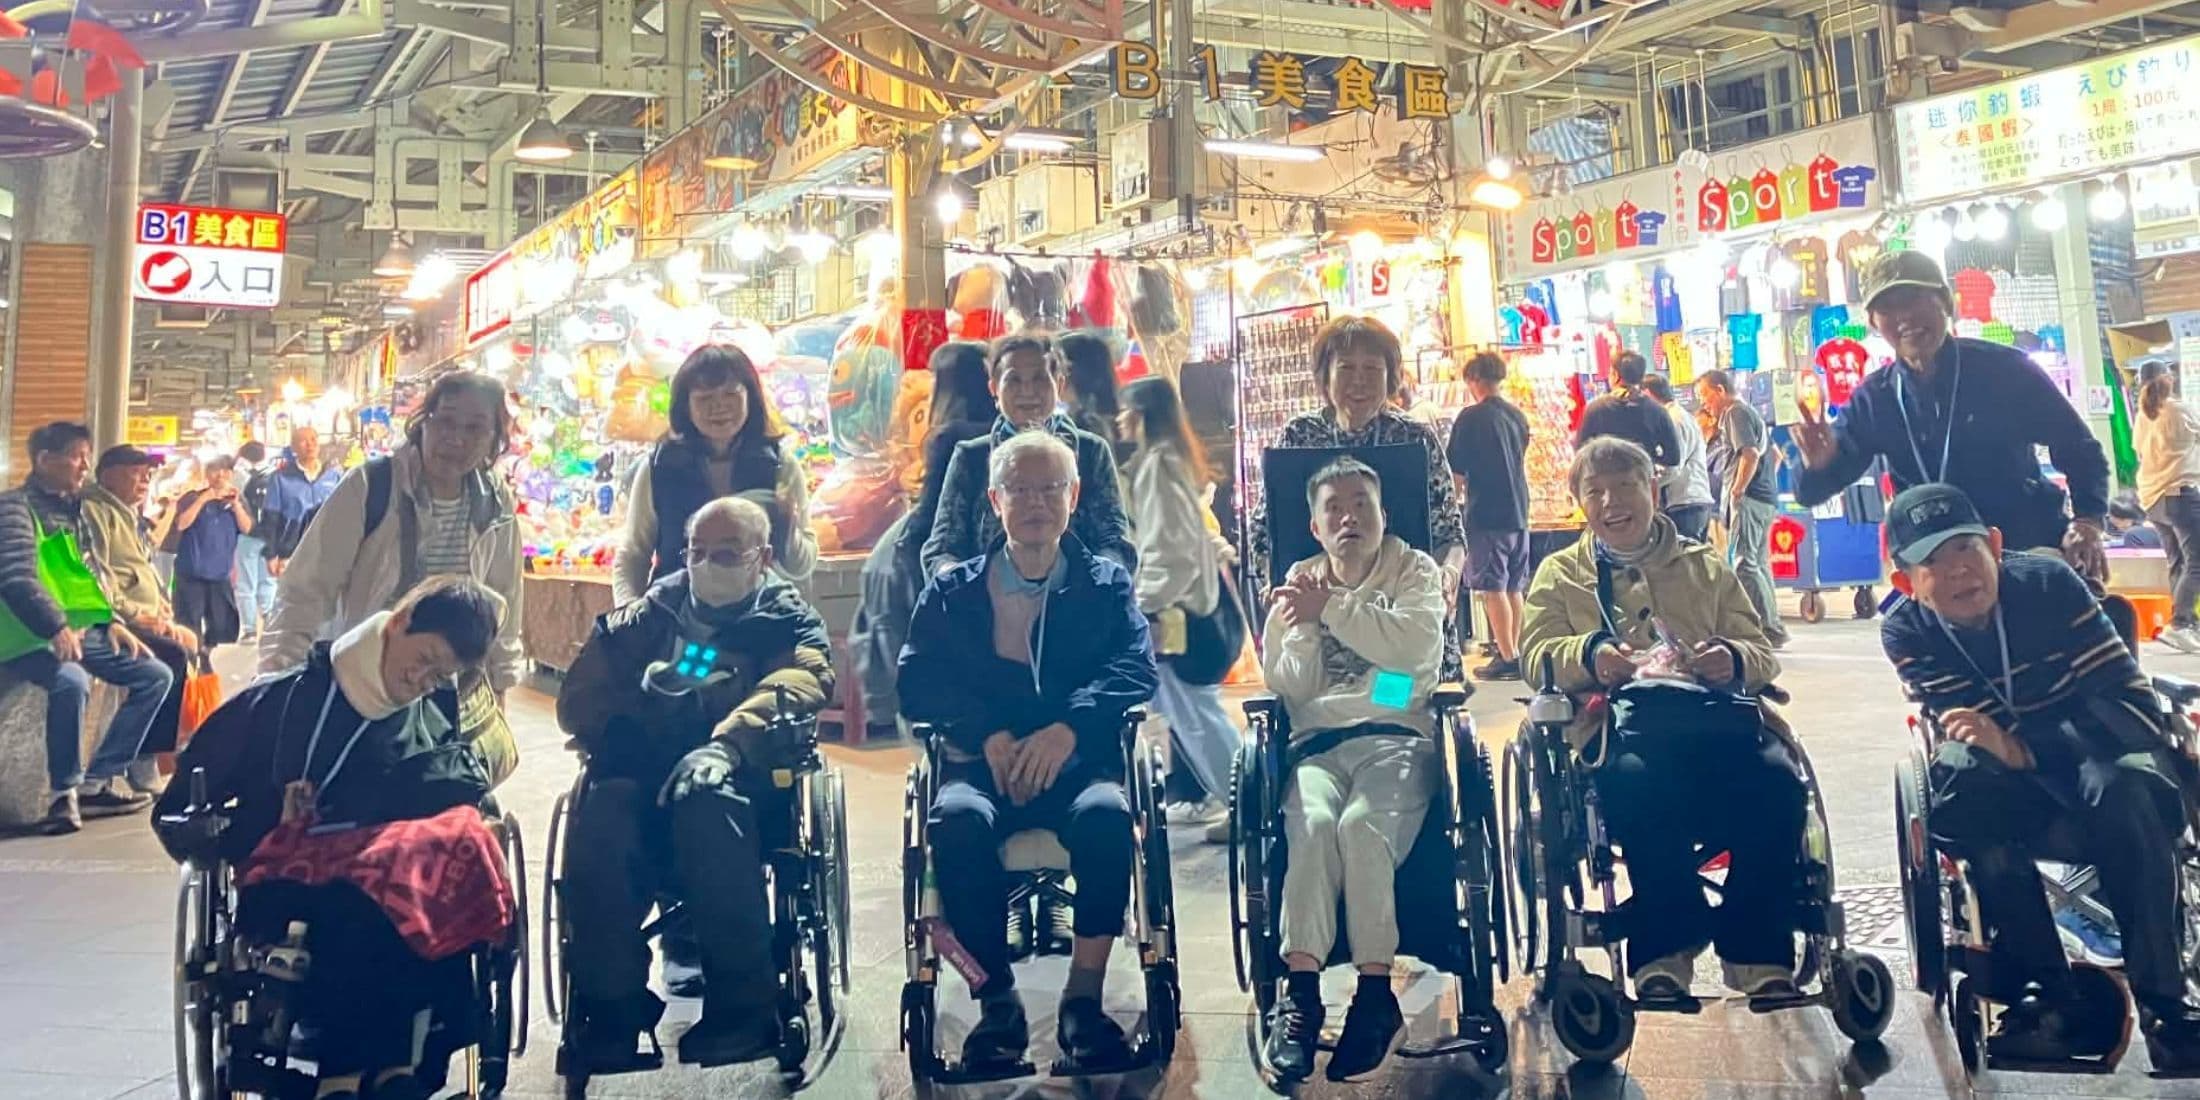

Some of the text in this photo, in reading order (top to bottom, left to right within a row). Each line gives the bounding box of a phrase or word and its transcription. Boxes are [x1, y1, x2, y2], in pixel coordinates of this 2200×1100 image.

[1702, 168, 1830, 227] Sport
[1535, 210, 1632, 260] Sport
[200, 260, 274, 294] 入口
